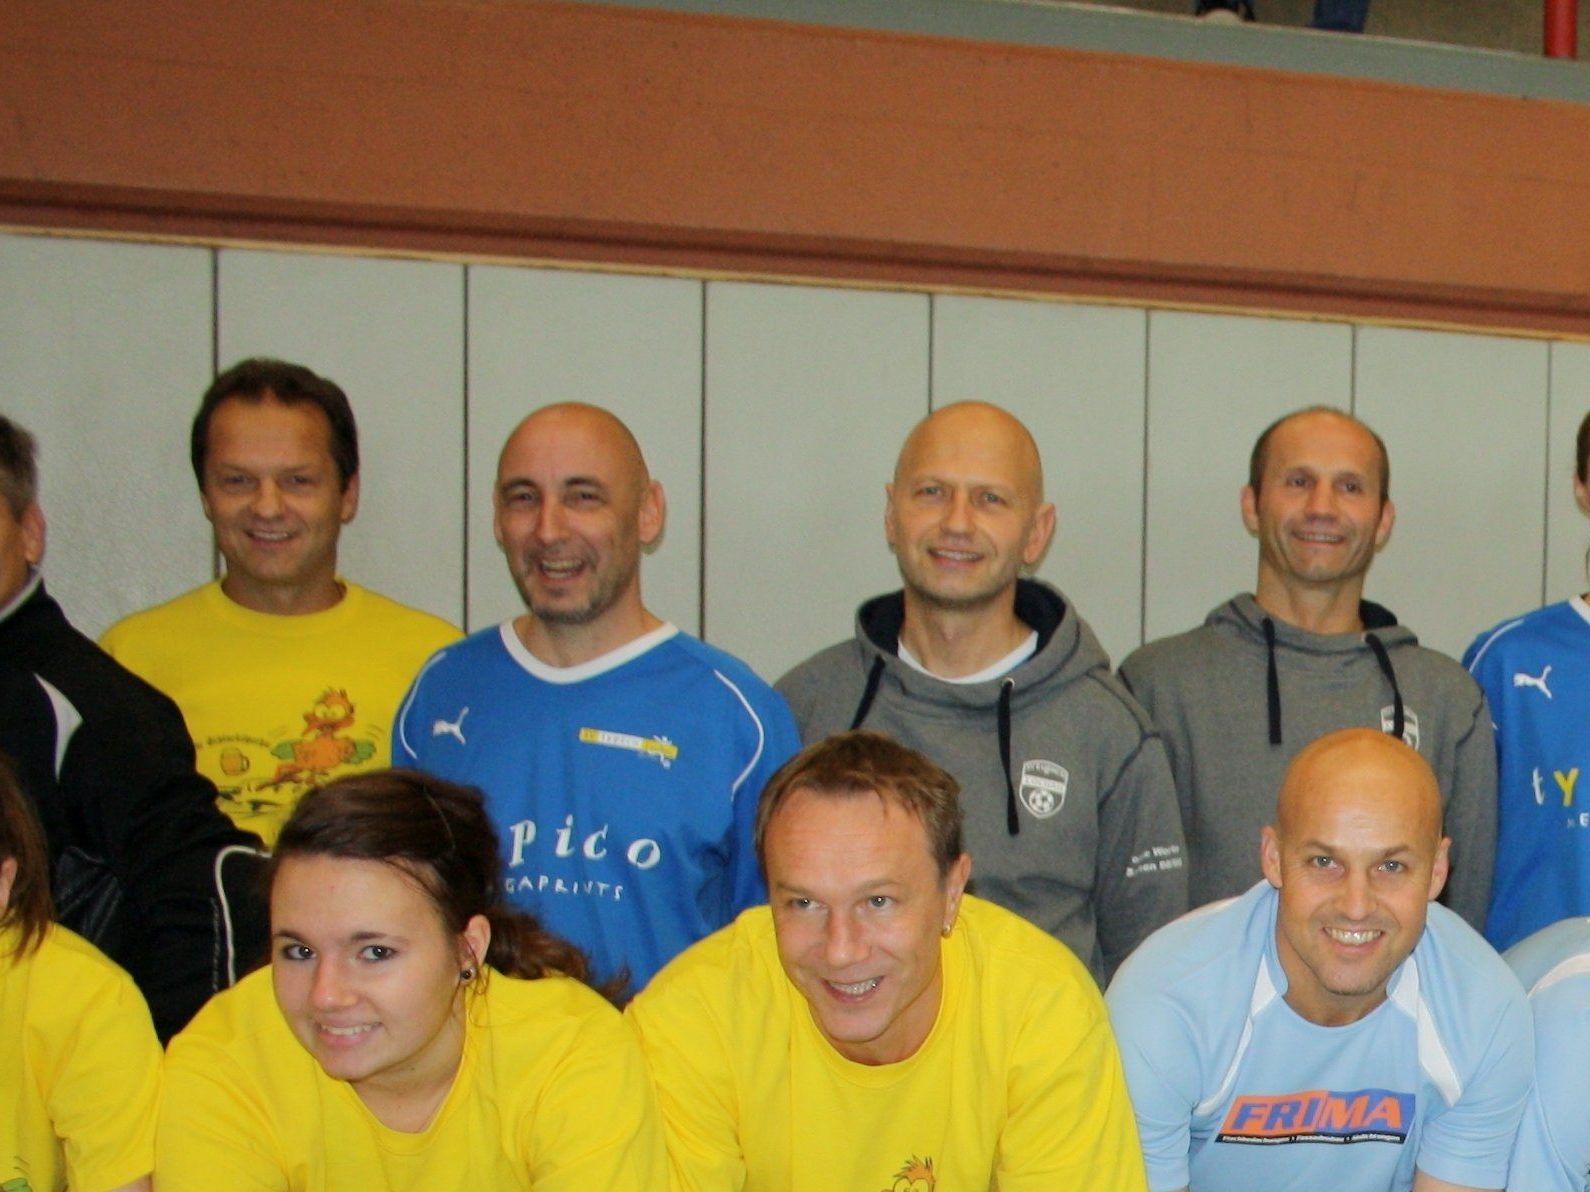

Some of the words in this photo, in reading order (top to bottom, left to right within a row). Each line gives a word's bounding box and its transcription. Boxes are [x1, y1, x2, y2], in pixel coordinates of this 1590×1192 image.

[508, 814, 661, 869] pico
[504, 875, 624, 900] GAPRINTS
[1232, 1095, 1404, 1131] FRIMA
